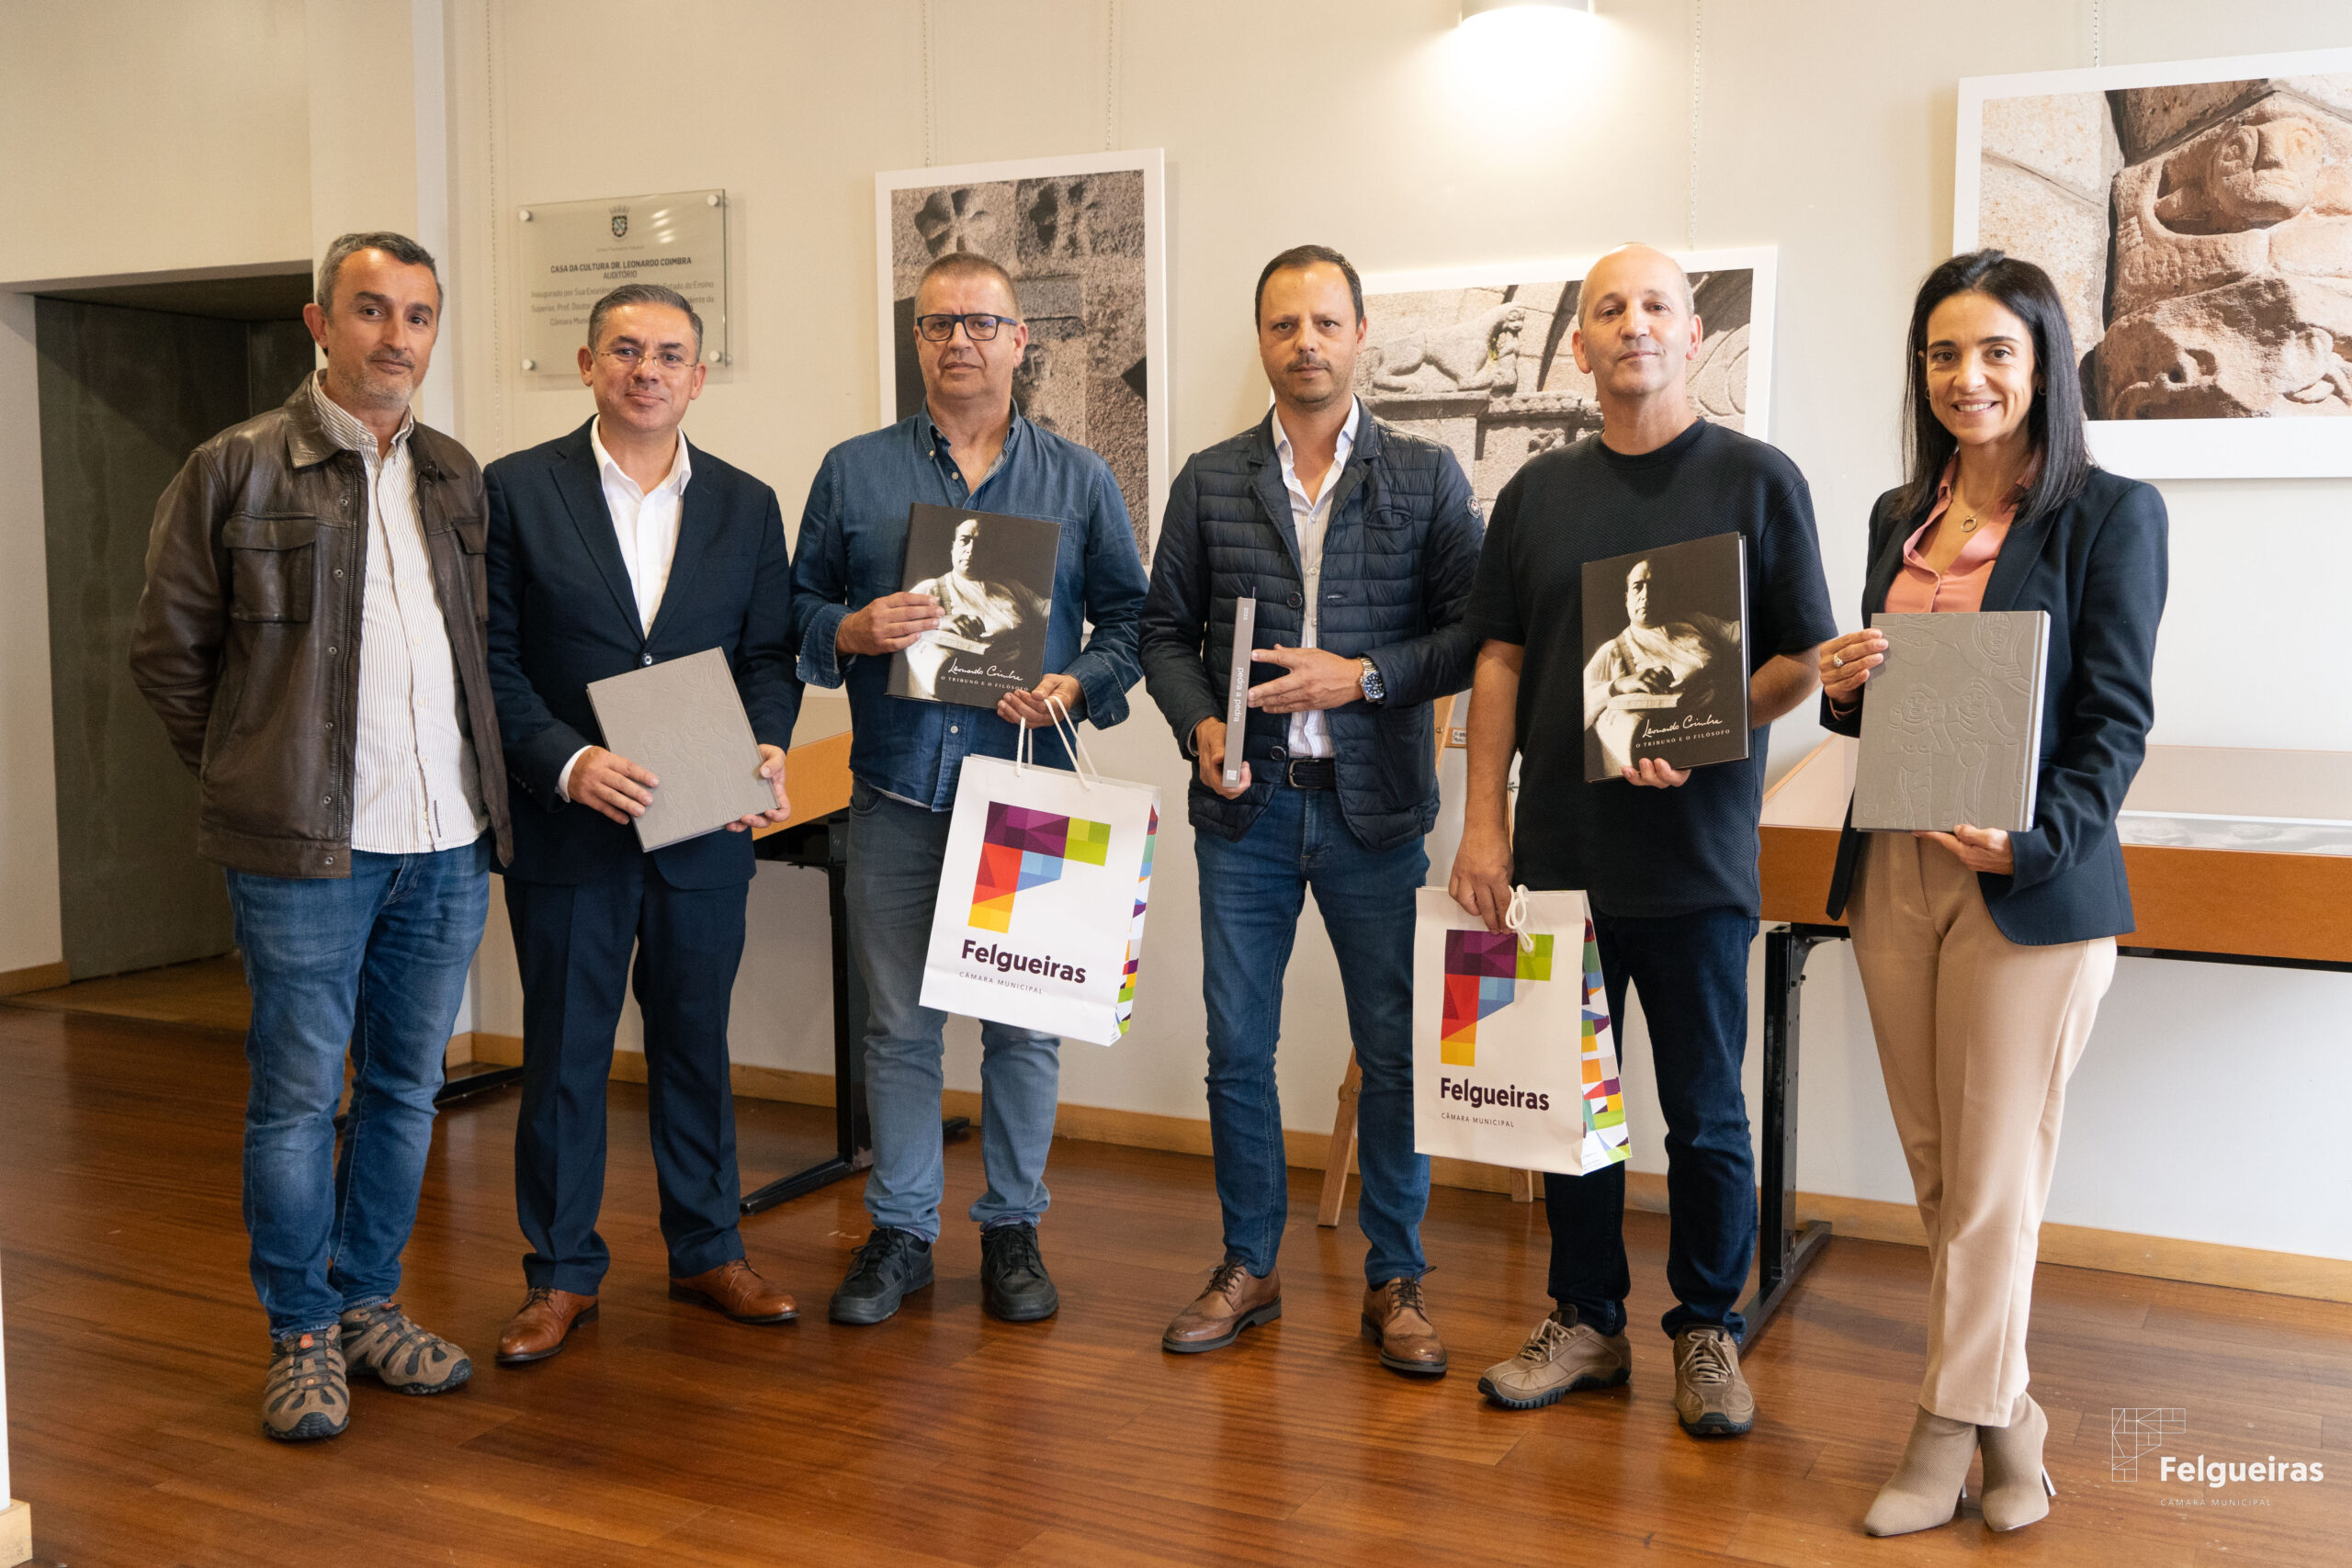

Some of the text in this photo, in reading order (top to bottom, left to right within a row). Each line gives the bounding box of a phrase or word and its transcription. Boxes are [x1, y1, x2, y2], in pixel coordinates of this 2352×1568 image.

[550, 265, 568, 273] CASA
[579, 263, 609, 272] CULTURA
[611, 261, 621, 269] DR.
[623, 259, 659, 268] LEONARDO
[661, 257, 692, 265] COIMBRA
[948, 677, 978, 685] TRIBUNO
[1236, 667, 1245, 691] pedra
[1233, 699, 1242, 722] pedra
[1644, 738, 1676, 747] TRIBUNO
[1693, 728, 1730, 739] FILÓSOFO
[961, 939, 1087, 984] Felgueiras
[959, 971, 1043, 994] CÂMARA MUNICIPAL
[1441, 1077, 1550, 1111] Felgueiras
[1441, 1112, 1515, 1128] CÂMARA MUNICIPAL
